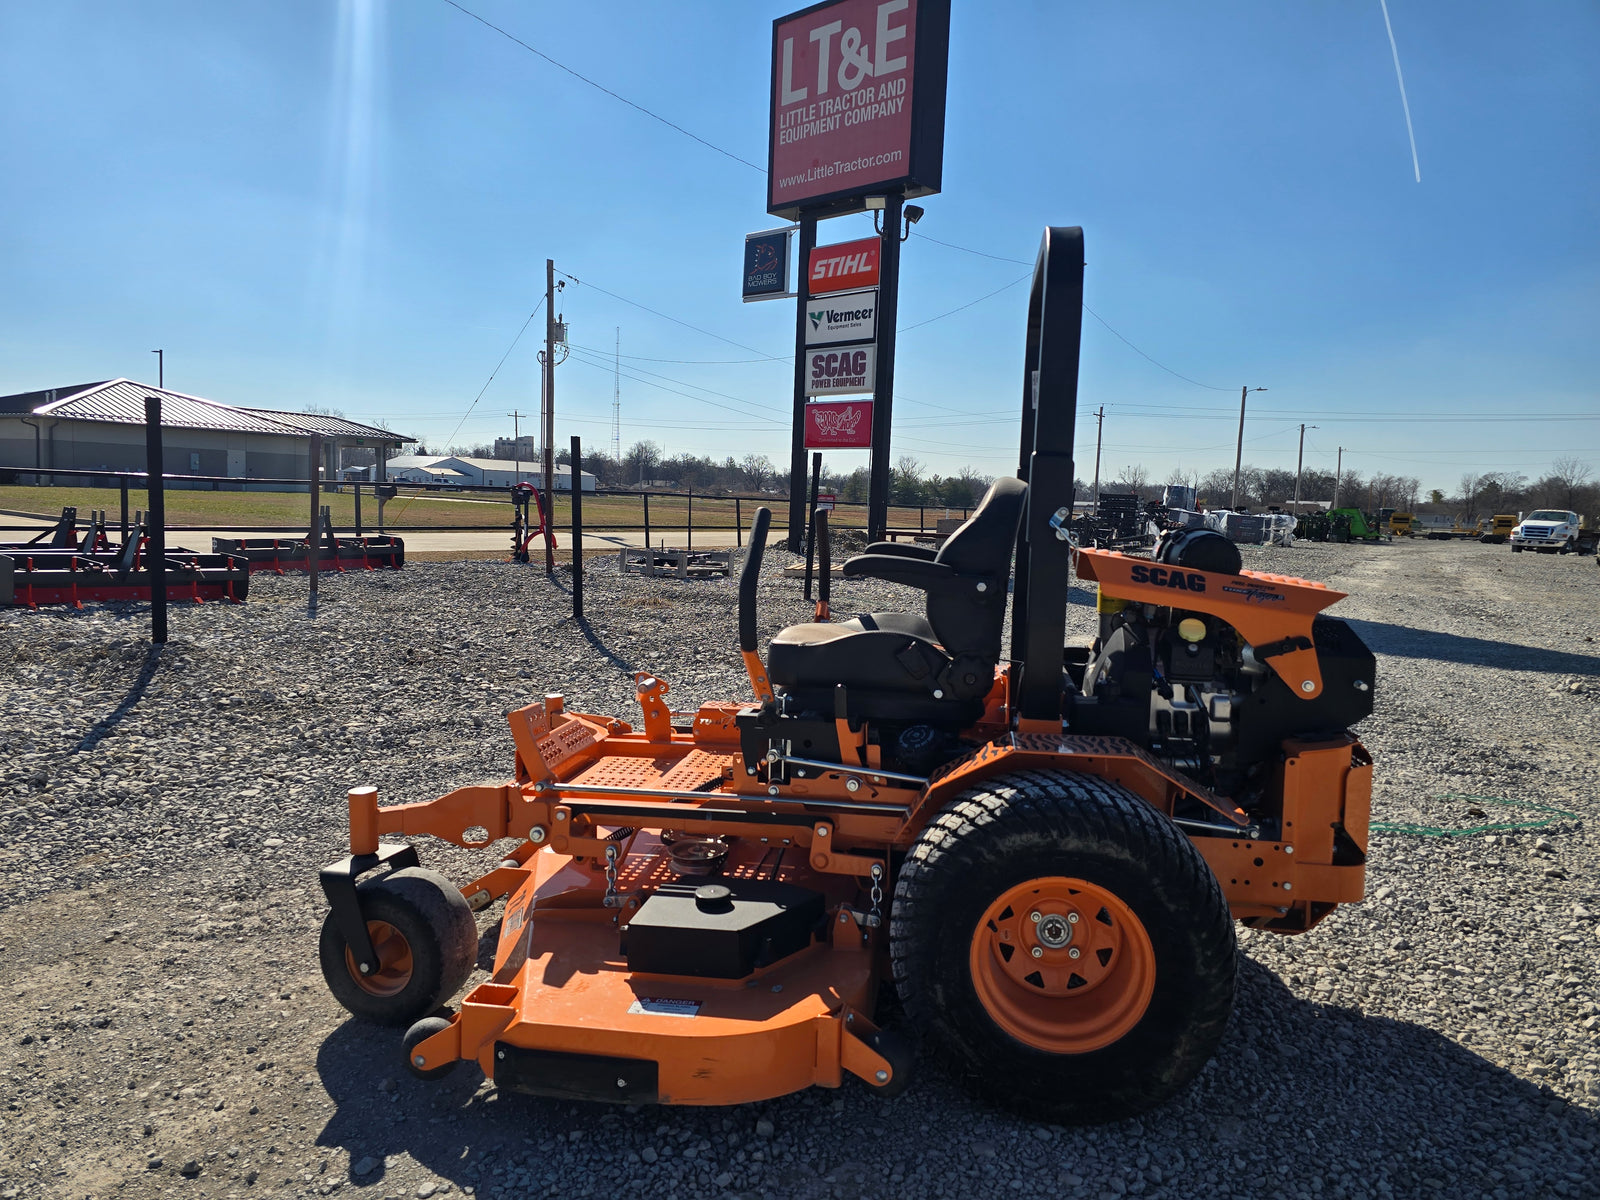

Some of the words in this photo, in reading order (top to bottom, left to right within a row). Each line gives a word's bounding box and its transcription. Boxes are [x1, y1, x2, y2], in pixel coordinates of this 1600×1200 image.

[781, 0, 908, 107] LT&E
[780, 104, 816, 129] LITTLE
[819, 87, 875, 117] TRACTOR
[878, 78, 906, 100] AND
[779, 114, 842, 145] EQUIPMENT
[844, 97, 905, 127] COMPANY
[779, 149, 902, 188] www.LittleTractor.com
[748, 274, 761, 282] BAD
[763, 272, 777, 280] BOY
[812, 252, 872, 280] STIHL
[747, 278, 777, 288] MOWERS
[826, 308, 873, 323] Vermeer
[827, 323, 850, 331] Equipment
[812, 350, 867, 379] SCAG
[811, 378, 831, 389] POWER
[832, 376, 866, 388] EQUIPMENT
[1131, 565, 1207, 593] SCAG
